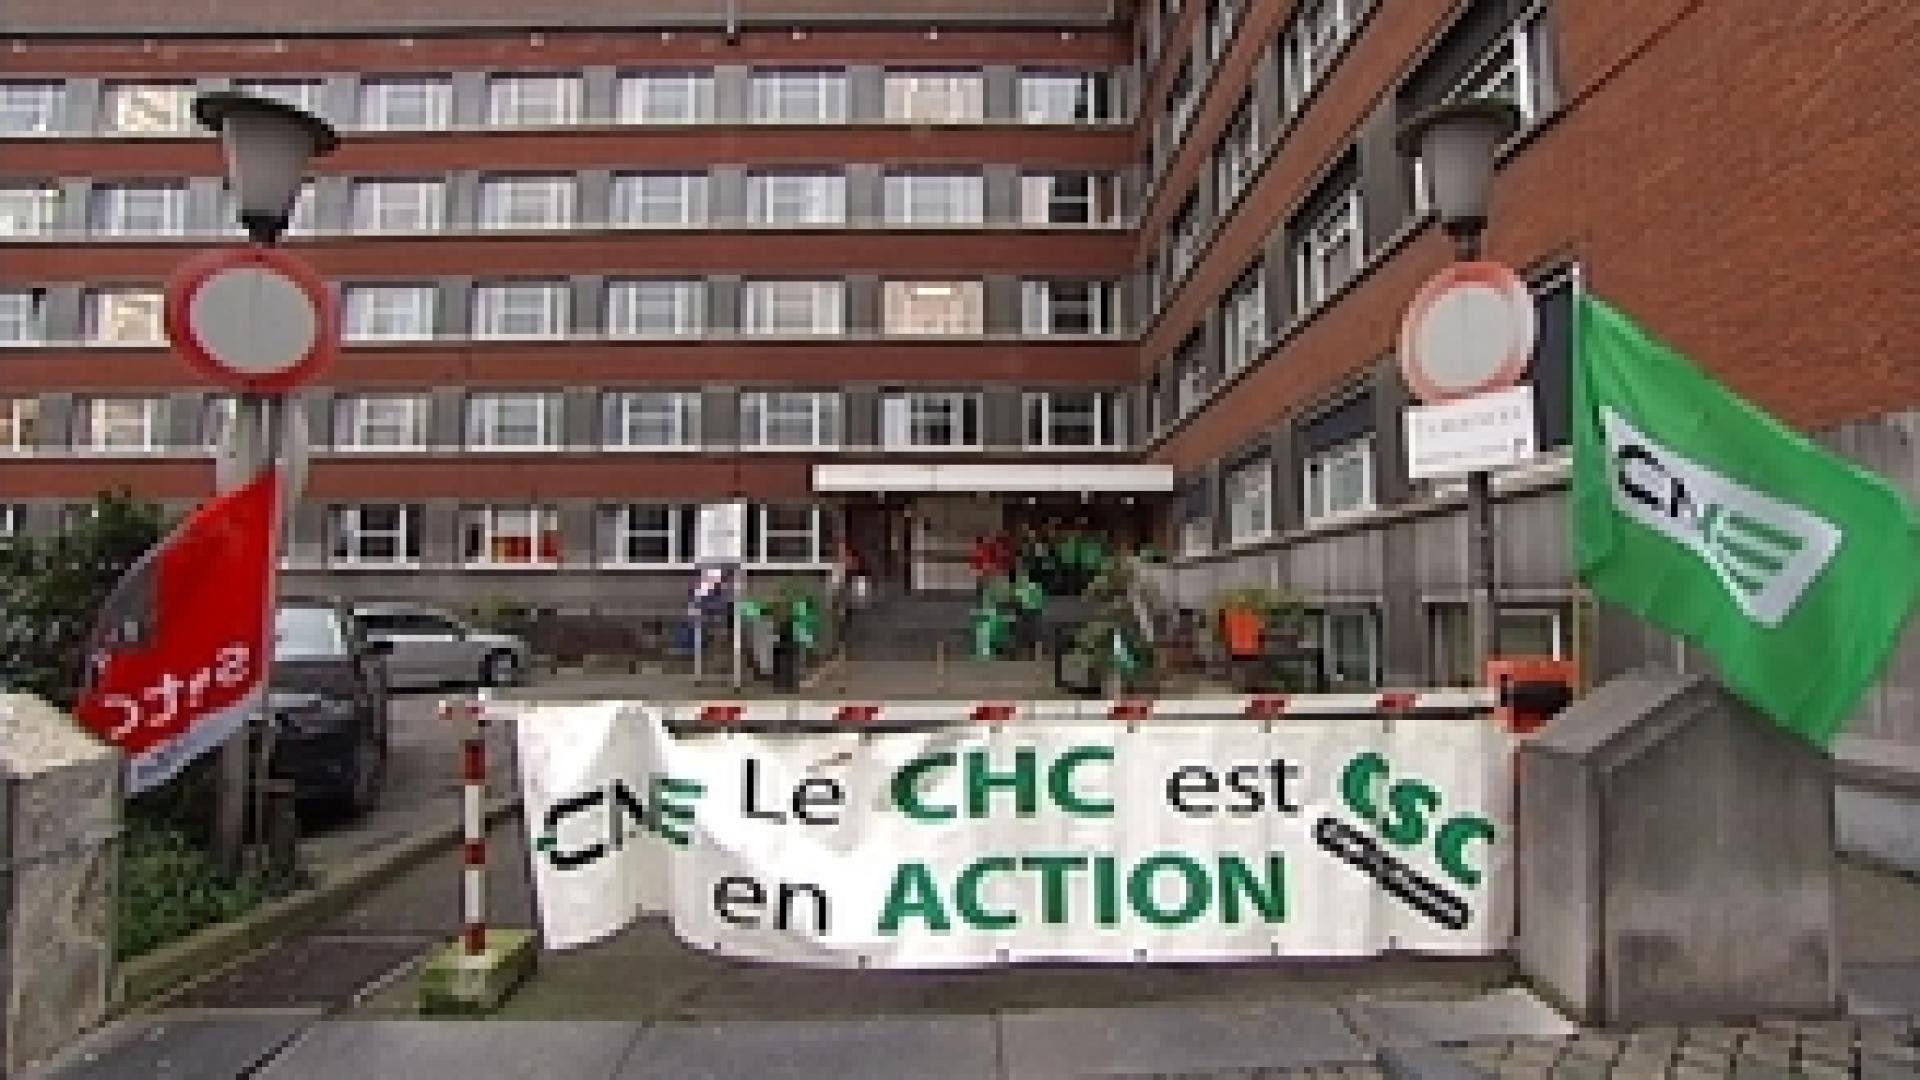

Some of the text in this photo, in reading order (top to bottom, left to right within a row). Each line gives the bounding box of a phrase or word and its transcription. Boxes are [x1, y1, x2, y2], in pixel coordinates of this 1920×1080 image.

[536, 778, 708, 869] CNE
[890, 745, 1115, 820] CHC
[1166, 758, 1299, 814] est
[713, 875, 835, 938] en
[876, 853, 1287, 938] ACTION
